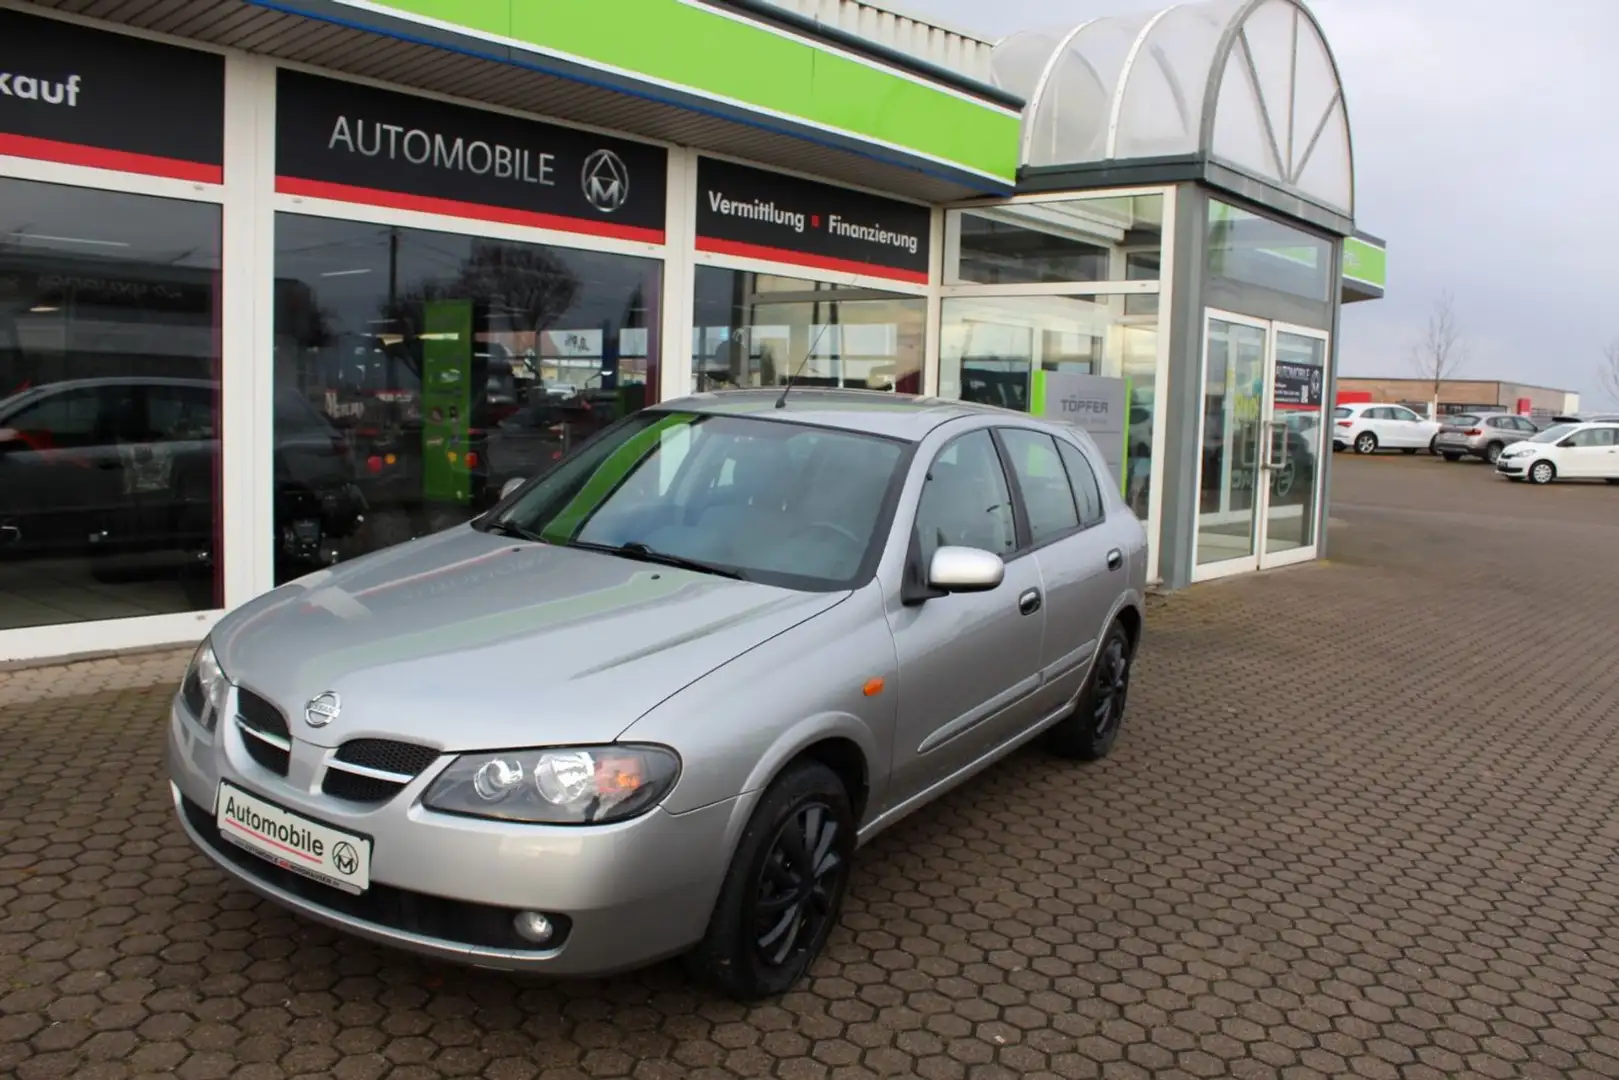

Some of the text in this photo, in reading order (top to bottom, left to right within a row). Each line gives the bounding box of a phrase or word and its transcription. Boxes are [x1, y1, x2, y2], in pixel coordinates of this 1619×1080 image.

[329, 113, 556, 186] AUTOMOBILE
[708, 190, 919, 255] Vermittlung Finanzierung
[1060, 393, 1109, 414] TÖPFER
[226, 796, 324, 857] Automobile
